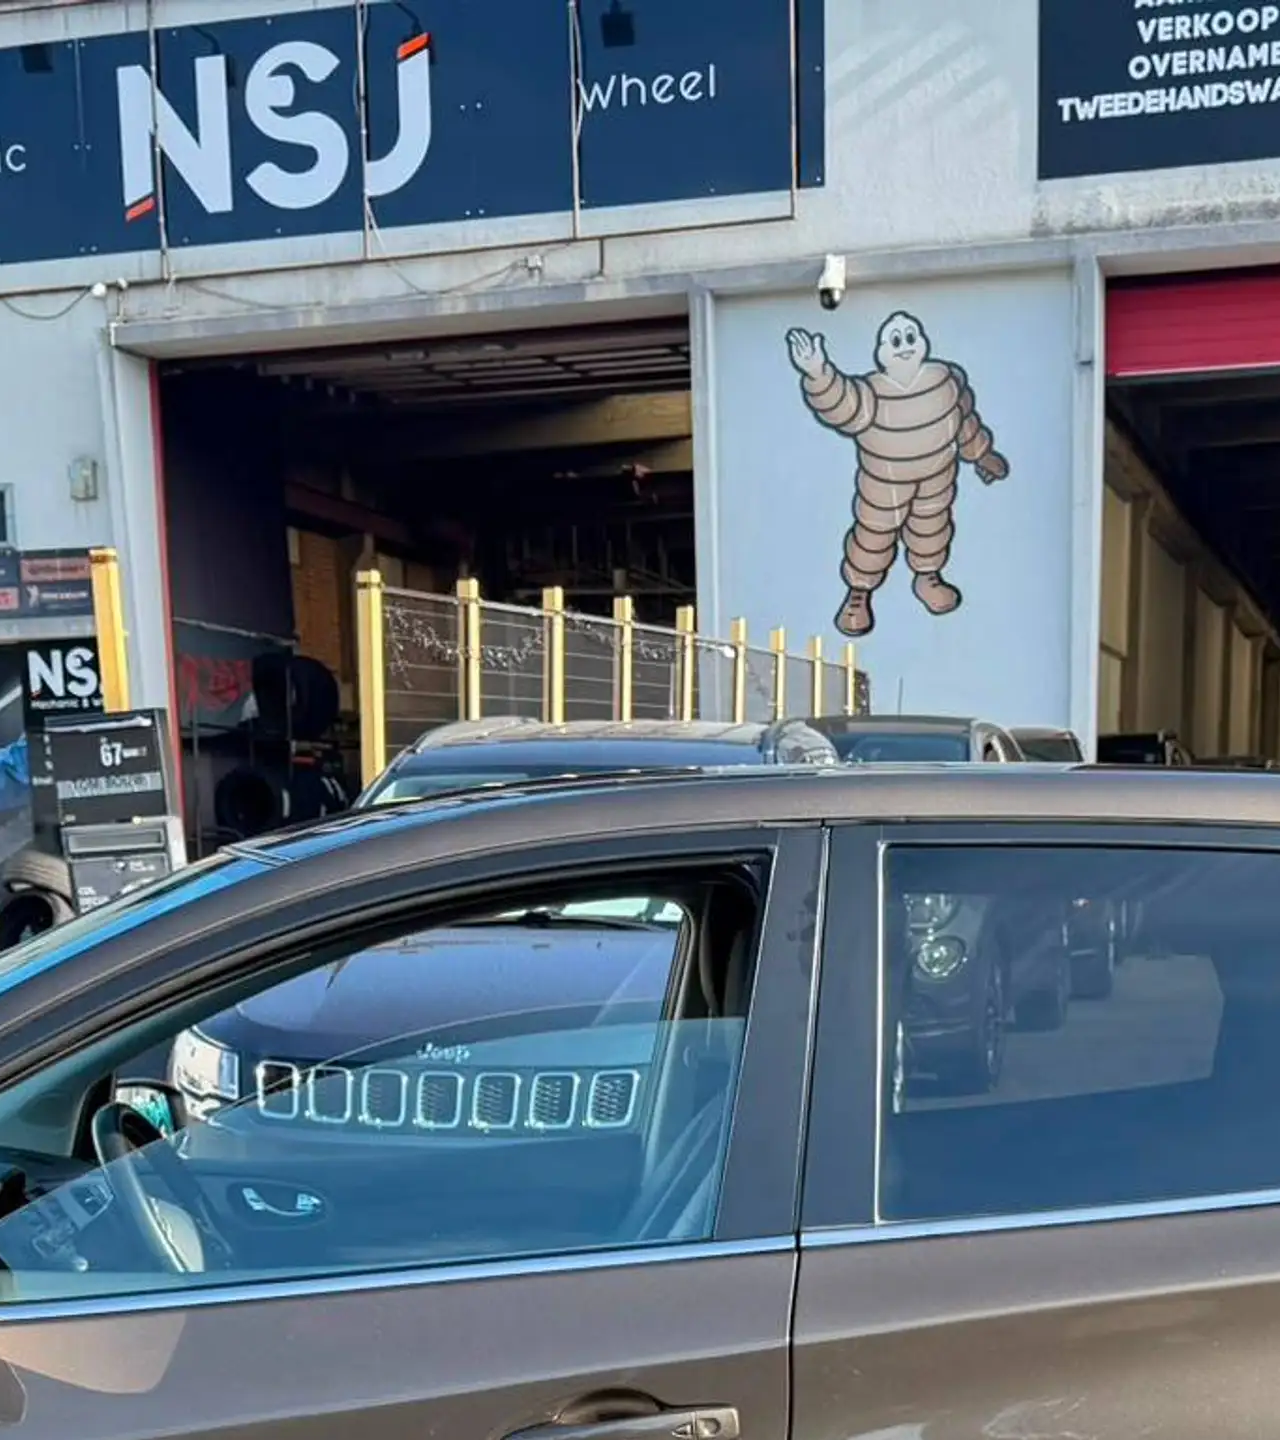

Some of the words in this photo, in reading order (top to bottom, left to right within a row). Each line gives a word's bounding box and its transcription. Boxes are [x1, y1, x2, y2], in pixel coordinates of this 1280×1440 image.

[1137, 6, 1279, 43] VERKOOP
[118, 33, 433, 222] NSJ
[27, 647, 103, 699] NS
